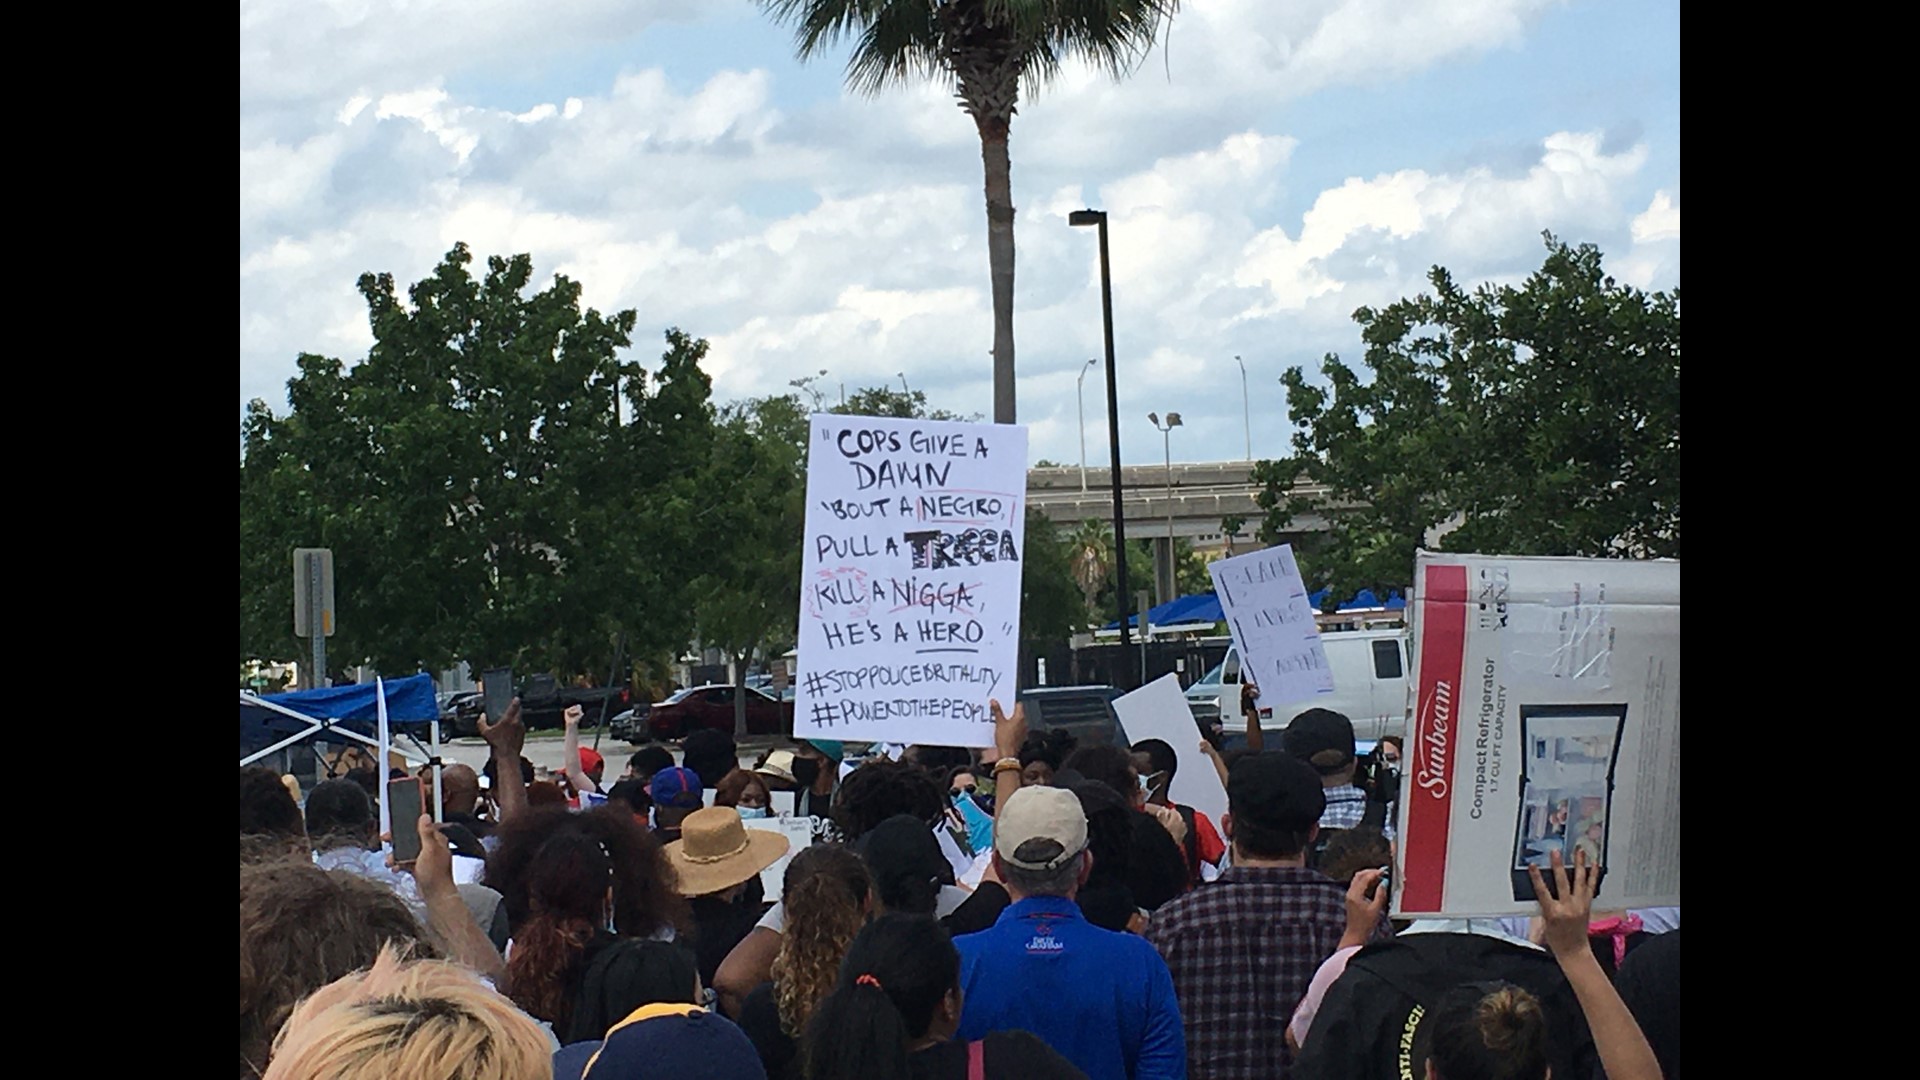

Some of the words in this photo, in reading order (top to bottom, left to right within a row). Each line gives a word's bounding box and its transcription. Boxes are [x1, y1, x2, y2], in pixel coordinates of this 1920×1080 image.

[910, 430, 967, 457] GIVE
[974, 437, 989, 459] A
[850, 459, 951, 490] DAMN
[900, 496, 914, 517] A
[921, 495, 1006, 521] NEGRO,
[816, 534, 879, 563] PULL
[886, 537, 898, 557] A
[872, 579, 885, 602] A
[822, 619, 882, 650] HE'S
[894, 622, 908, 643] A
[1476, 657, 1495, 749] Refrigerator
[1494, 684, 1507, 741] CAPACITY
[1417, 680, 1452, 799] Sunbeam
[1470, 751, 1487, 819] Compact
[1399, 1004, 1425, 1080] NTI-FASCI
